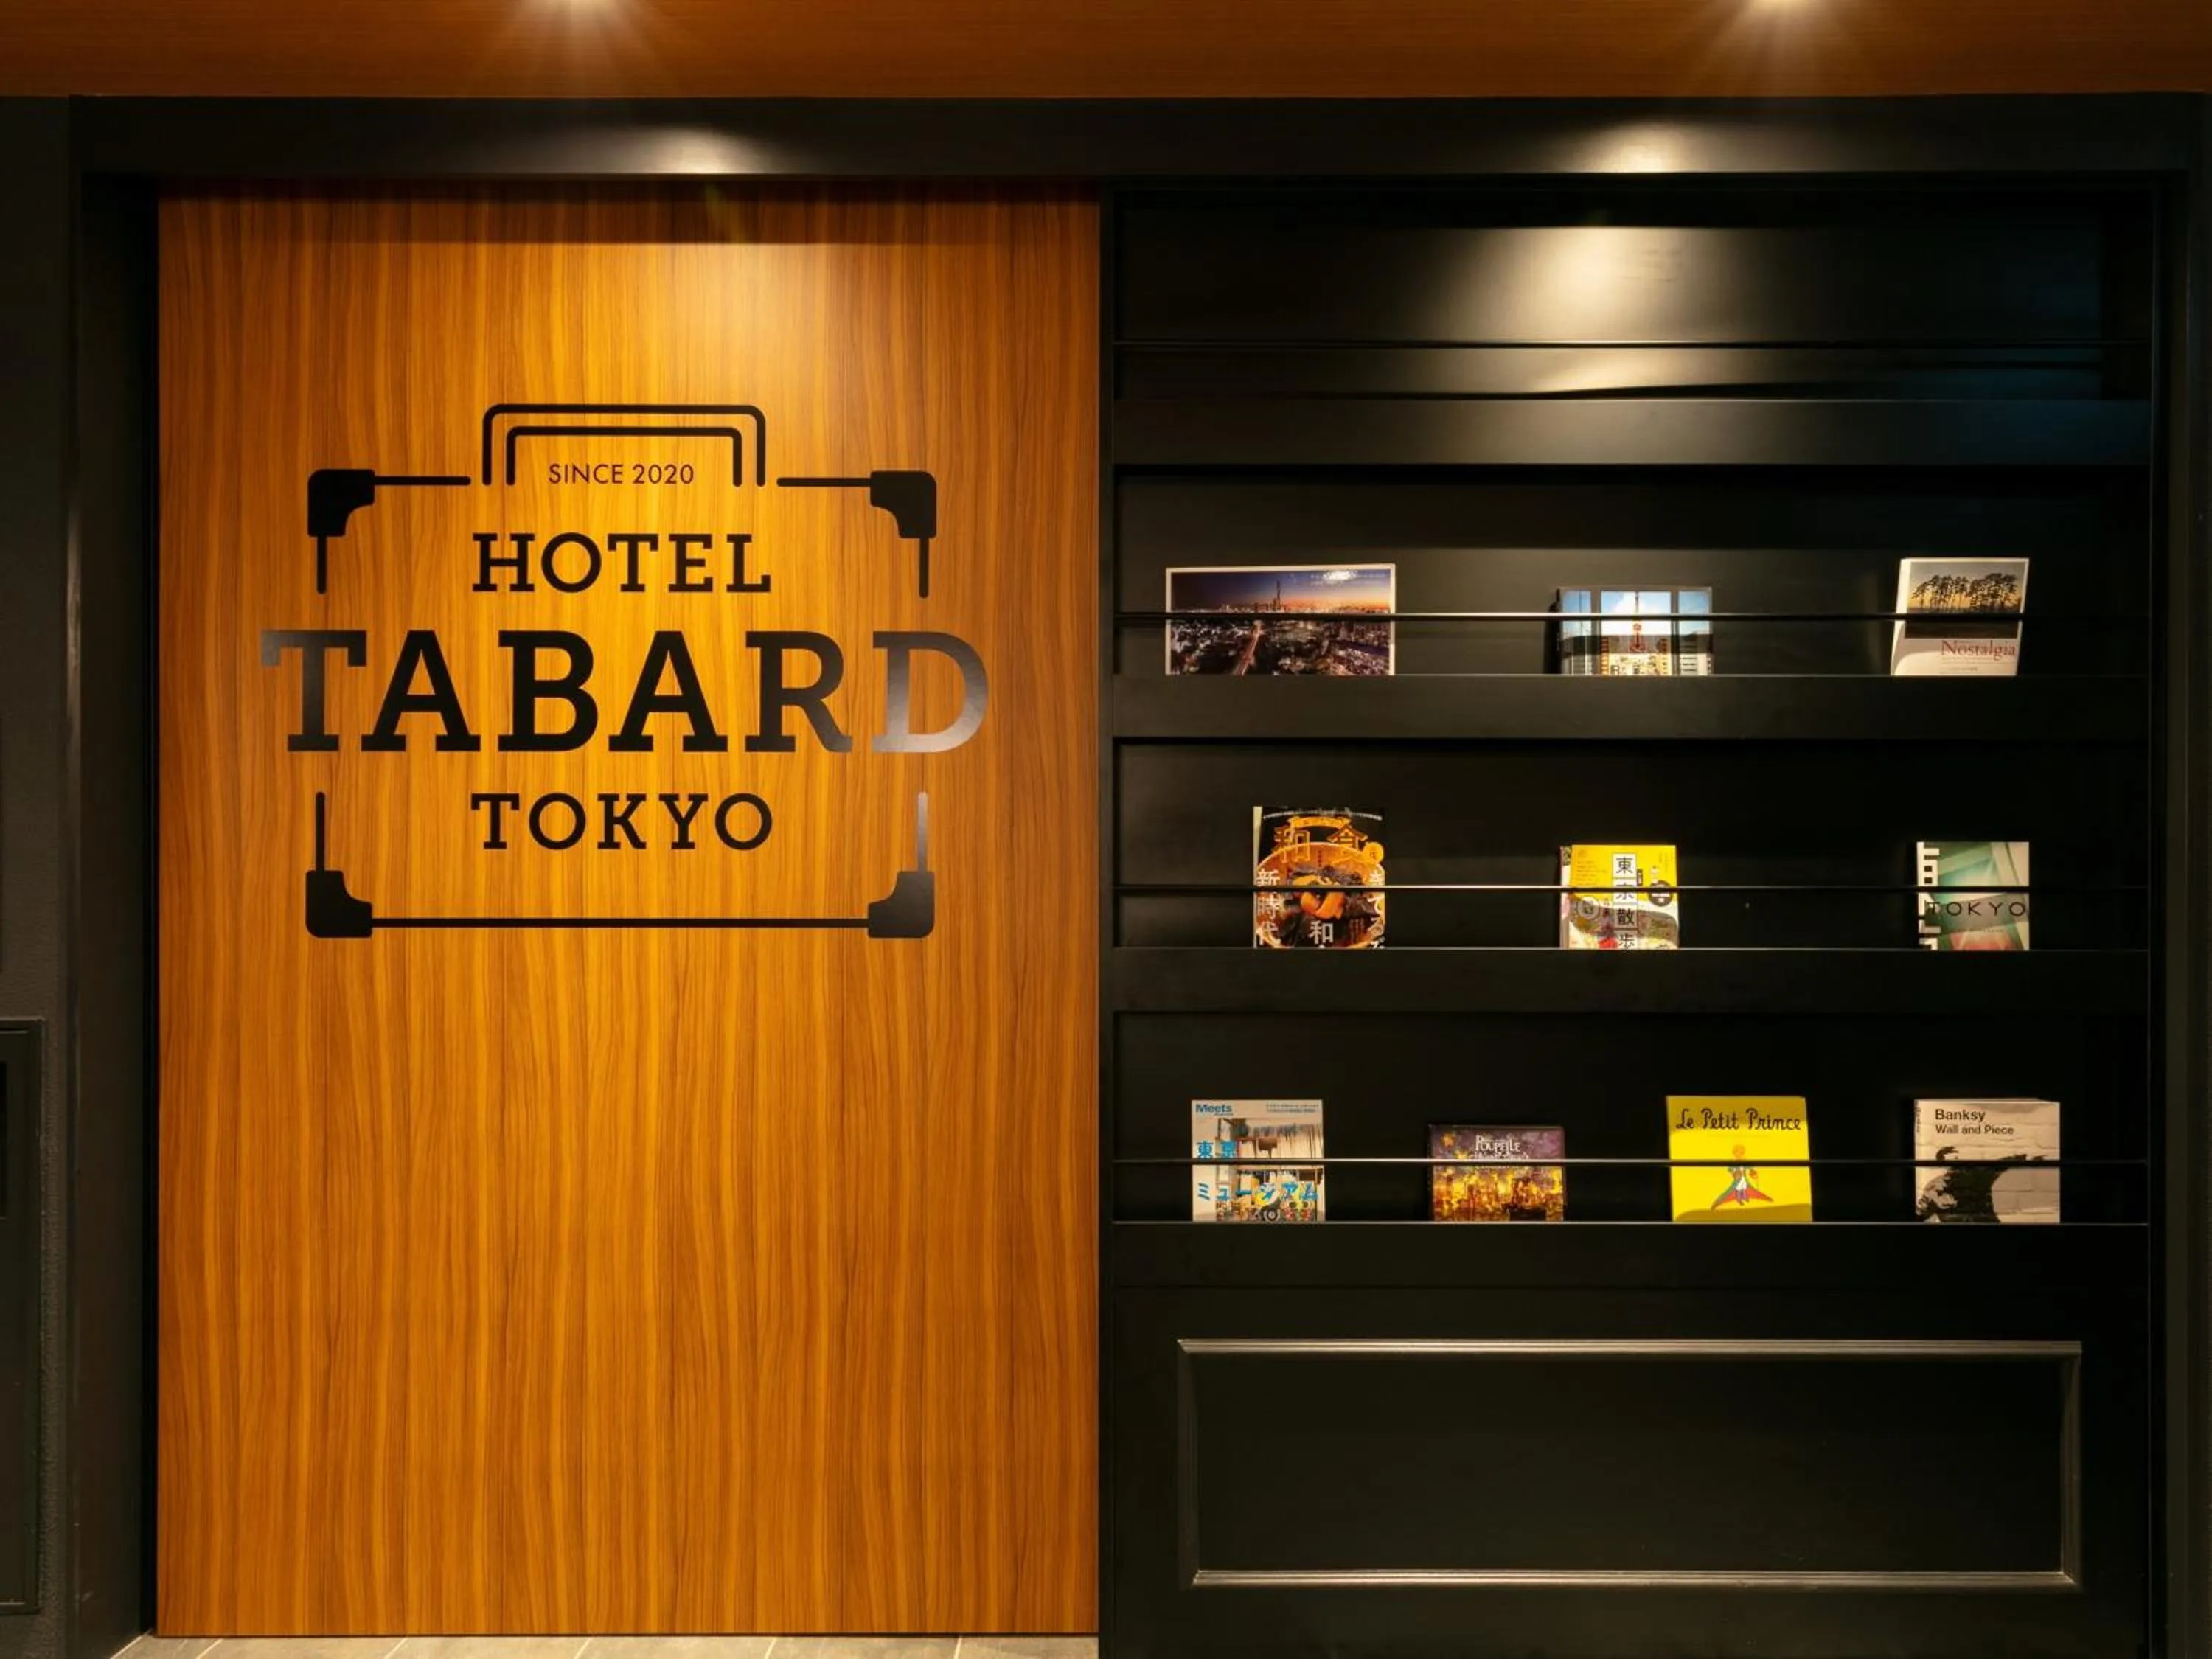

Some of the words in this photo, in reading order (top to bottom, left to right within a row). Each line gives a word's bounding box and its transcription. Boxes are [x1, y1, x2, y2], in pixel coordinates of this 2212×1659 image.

[548, 463, 624, 485] SINCE
[632, 463, 695, 485] 2020
[472, 531, 771, 594] HOTEL
[1941, 639, 2016, 661] Nostalgia
[260, 629, 989, 753] TABARD
[470, 792, 773, 851] TOKYO
[1615, 856, 1635, 949] 東京散歩
[1925, 902, 2026, 917] TOKYO
[1307, 920, 1334, 948] 和
[1196, 1104, 1233, 1113] Meets
[1675, 1108, 1694, 1130] Le
[1701, 1107, 1739, 1130] Petit
[1746, 1107, 1802, 1131] Prince
[1935, 1109, 1986, 1123] Banksy
[1935, 1124, 1959, 1134] Wall
[1962, 1125, 1981, 1134] and
[1984, 1124, 2014, 1135] Piece
[1197, 1141, 1237, 1161] 東京
[1197, 1181, 1318, 1201] ミュージアム
